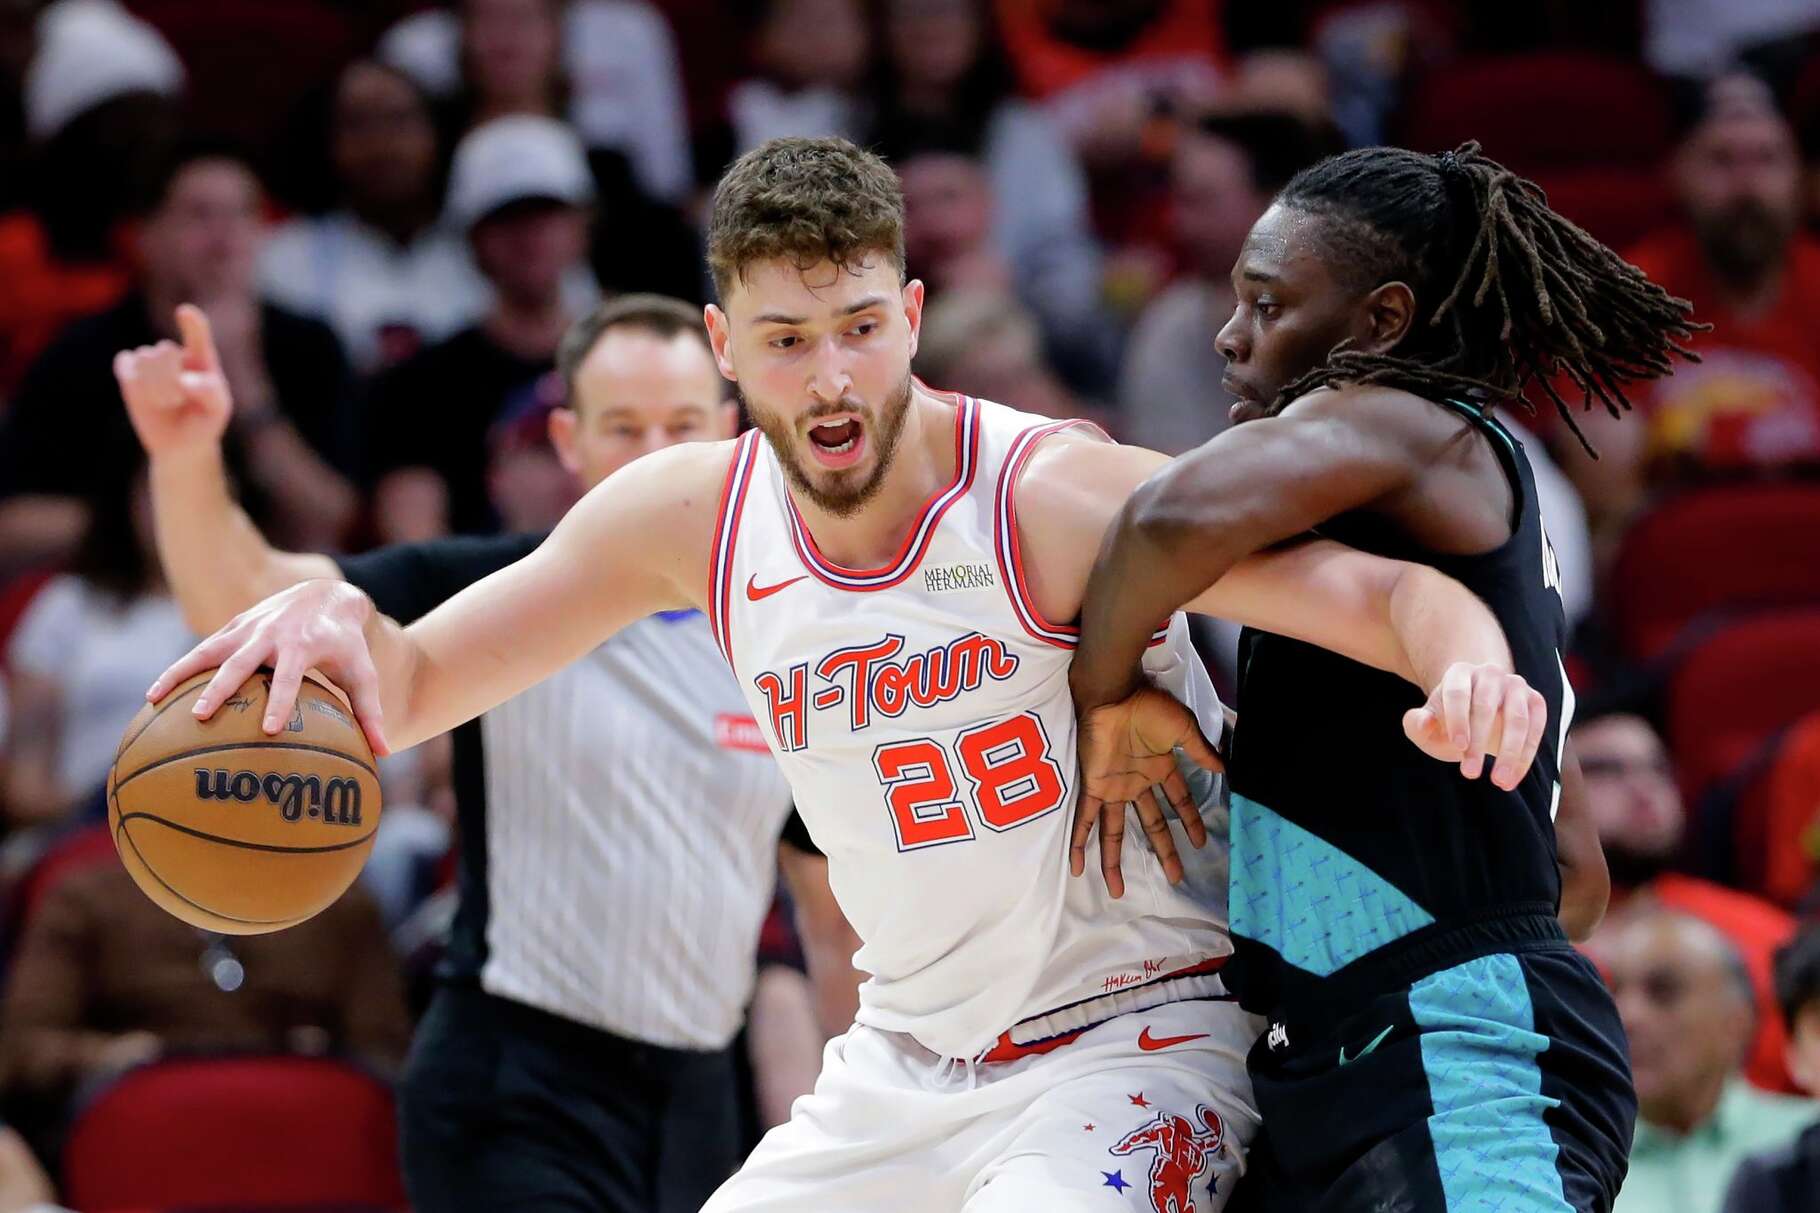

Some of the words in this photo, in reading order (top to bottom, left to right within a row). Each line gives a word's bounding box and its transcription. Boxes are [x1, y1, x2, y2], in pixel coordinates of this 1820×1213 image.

[924, 564, 991, 583] MEMORIAL
[926, 574, 994, 592] HERMANN
[754, 631, 1020, 752] H-Town
[194, 768, 362, 826] Wilson
[872, 710, 1068, 853] 28
